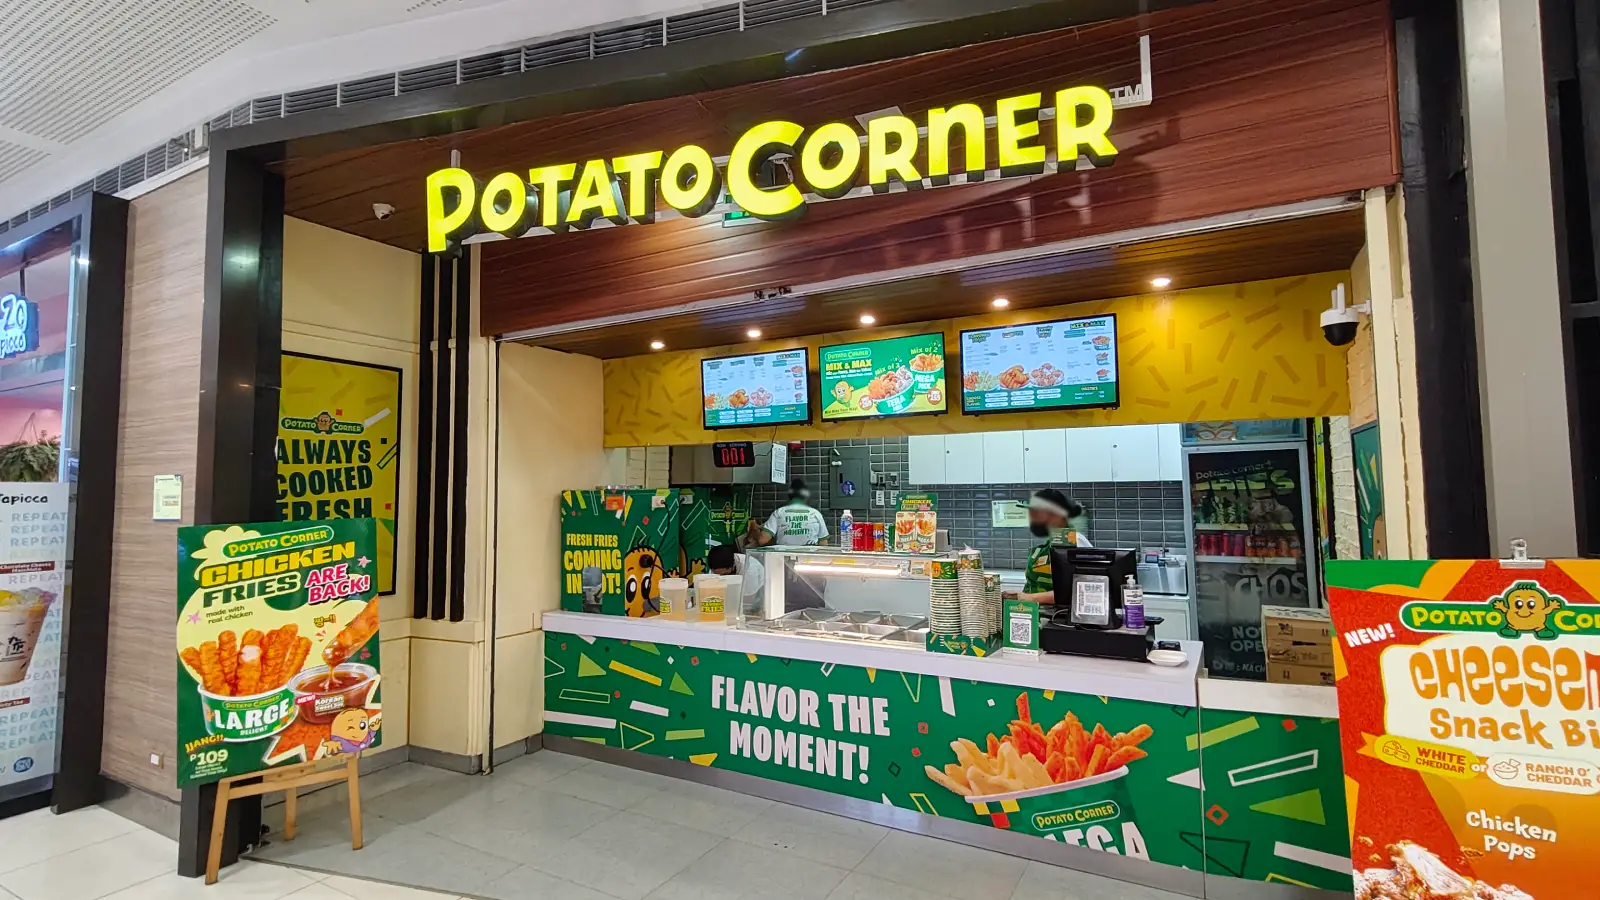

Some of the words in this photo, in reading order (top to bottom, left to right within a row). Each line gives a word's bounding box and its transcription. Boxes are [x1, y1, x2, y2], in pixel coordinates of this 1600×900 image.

[426, 145, 714, 253] POTATO
[727, 85, 1118, 215] CORNER
[285, 419, 316, 428] POTATO
[332, 423, 361, 432] CORNER
[278, 439, 371, 464] ALWAYS
[722, 448, 746, 465] 001
[277, 465, 373, 500] COOKED
[12, 511, 66, 522] REPEAT
[276, 497, 372, 521] FRESH
[10, 523, 65, 534] REPEAT
[10, 536, 64, 547] REPEAT
[228, 539, 277, 557] POTATO
[280, 530, 328, 547] CORNER
[566, 533, 593, 546] FRESH
[594, 534, 618, 547] FRIES
[201, 541, 356, 588] CHICKEN
[564, 550, 622, 570] COMING
[8, 572, 63, 584] REPEAT
[305, 563, 348, 588] ARE
[566, 574, 583, 594] IN
[601, 574, 621, 594] OT!
[203, 574, 300, 608] FRIES
[308, 575, 371, 604] BACK!
[206, 608, 227, 618] made
[228, 605, 245, 613] with
[224, 611, 254, 621] chicken
[1411, 607, 1502, 627] POTATO
[1231, 626, 1261, 639] NO
[1344, 622, 1396, 648] NEW!
[1230, 640, 1264, 653] OPE
[316, 695, 344, 706] Korean
[712, 674, 820, 727] FLAVOR
[828, 693, 890, 736] THE
[214, 698, 290, 729] LARGE
[240, 725, 268, 735] DELIGHT
[1430, 708, 1554, 749] Snack
[730, 720, 869, 784] MOMENT!
[1416, 746, 1467, 766] WHITE
[1415, 757, 1466, 774] CHEDDAR
[1471, 762, 1488, 773] or
[1525, 762, 1574, 775] RANCH
[1526, 772, 1593, 788] CHEDDAR
[1036, 813, 1074, 828] POTATO
[1075, 805, 1115, 821] CORNER
[1465, 809, 1557, 843] Chicken
[1044, 822, 1150, 861] GA
[1483, 834, 1536, 861] Pops
